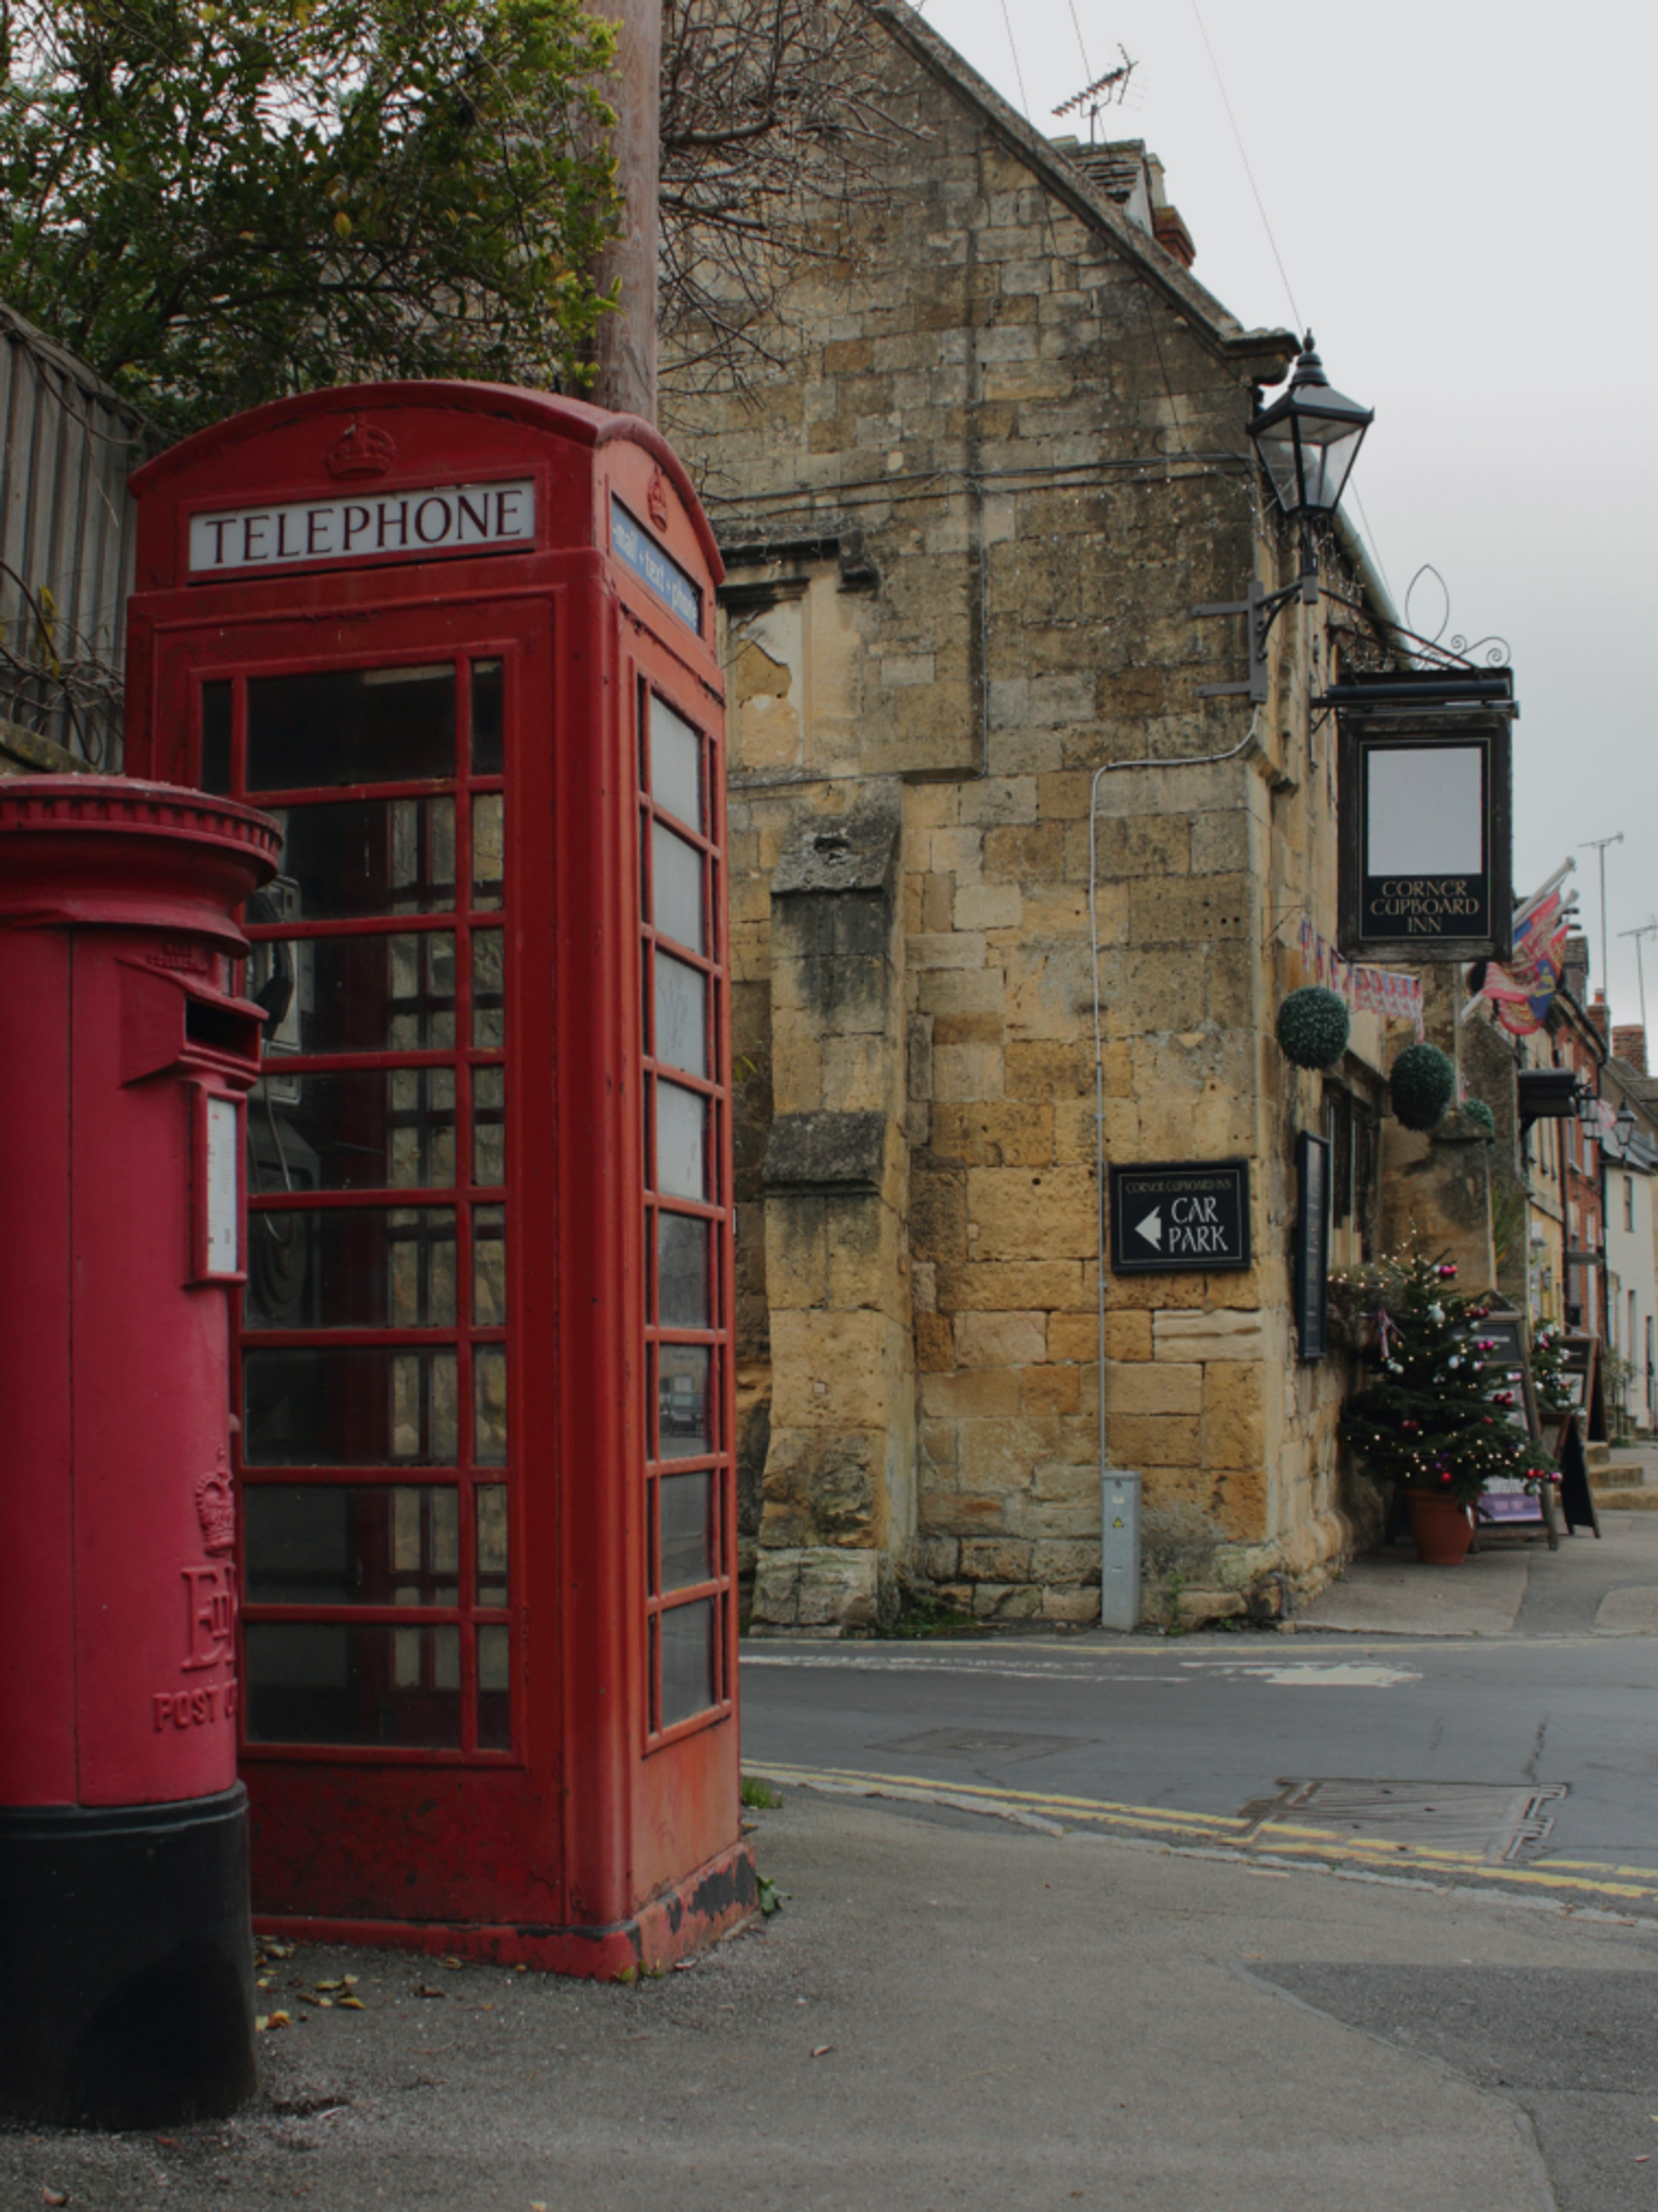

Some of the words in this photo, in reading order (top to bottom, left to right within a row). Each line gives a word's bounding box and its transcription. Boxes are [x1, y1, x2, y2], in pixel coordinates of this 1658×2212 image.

[205, 491, 522, 564] TELEPHONE
[1382, 880, 1467, 897] CORNER
[1370, 898, 1480, 915] CUPBOARD
[1407, 916, 1442, 933] INN
[1171, 1196, 1218, 1224] CAR
[1169, 1226, 1228, 1253] PARK
[153, 1685, 218, 1734] POST
